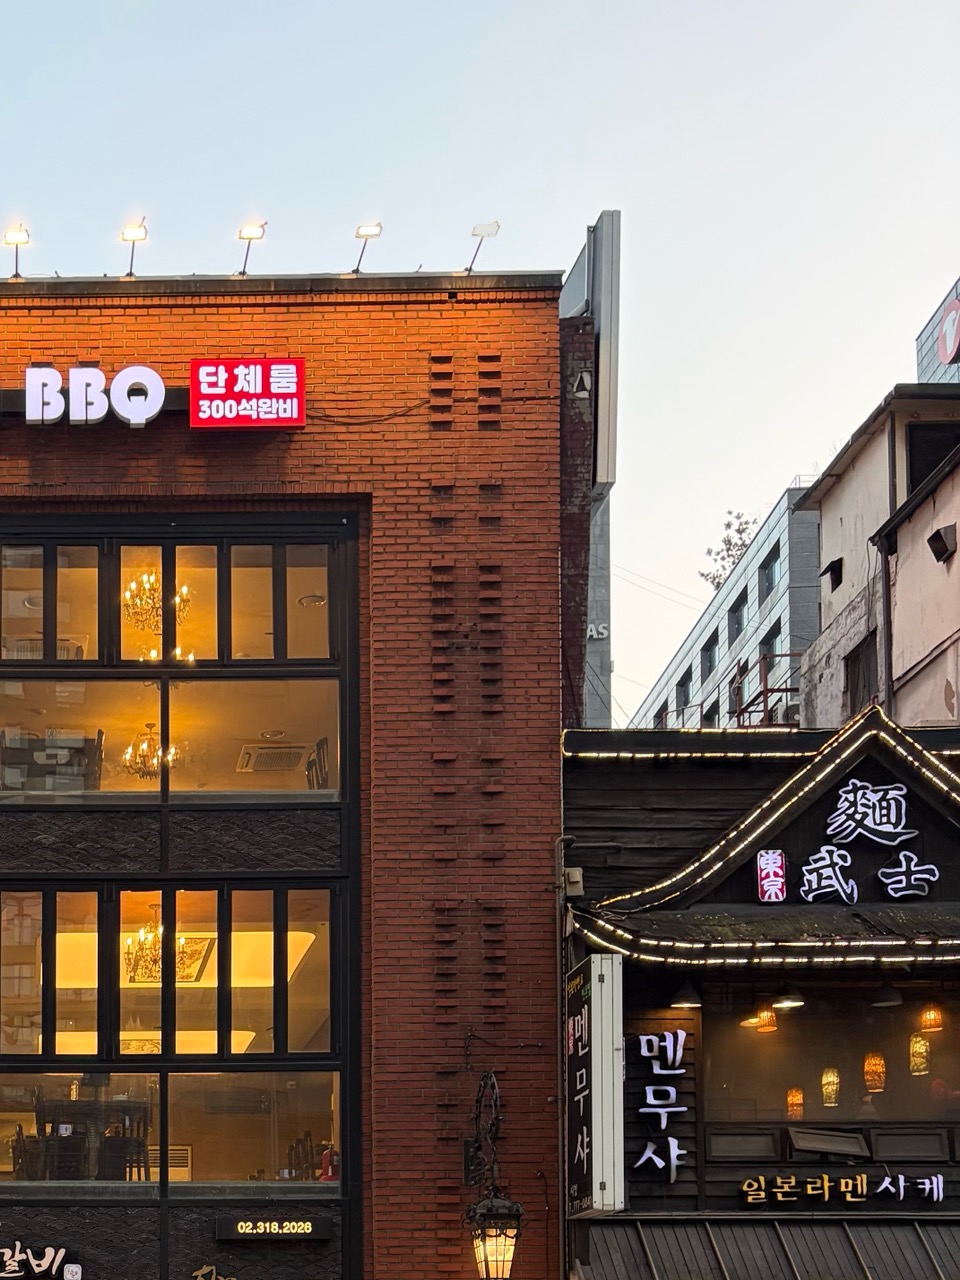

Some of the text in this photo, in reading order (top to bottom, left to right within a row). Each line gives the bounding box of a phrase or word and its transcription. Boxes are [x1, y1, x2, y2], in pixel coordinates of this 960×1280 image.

[198, 363, 299, 395] 단체룸
[24, 364, 167, 429] BBQ
[198, 396, 299, 421] 300석완비
[573, 1003, 590, 1175] 멘무샤
[633, 1029, 689, 1184] 멘무샤
[741, 1173, 945, 1203] 일본라멘 사케
[236, 1221, 314, 1235] 02.318.2026
